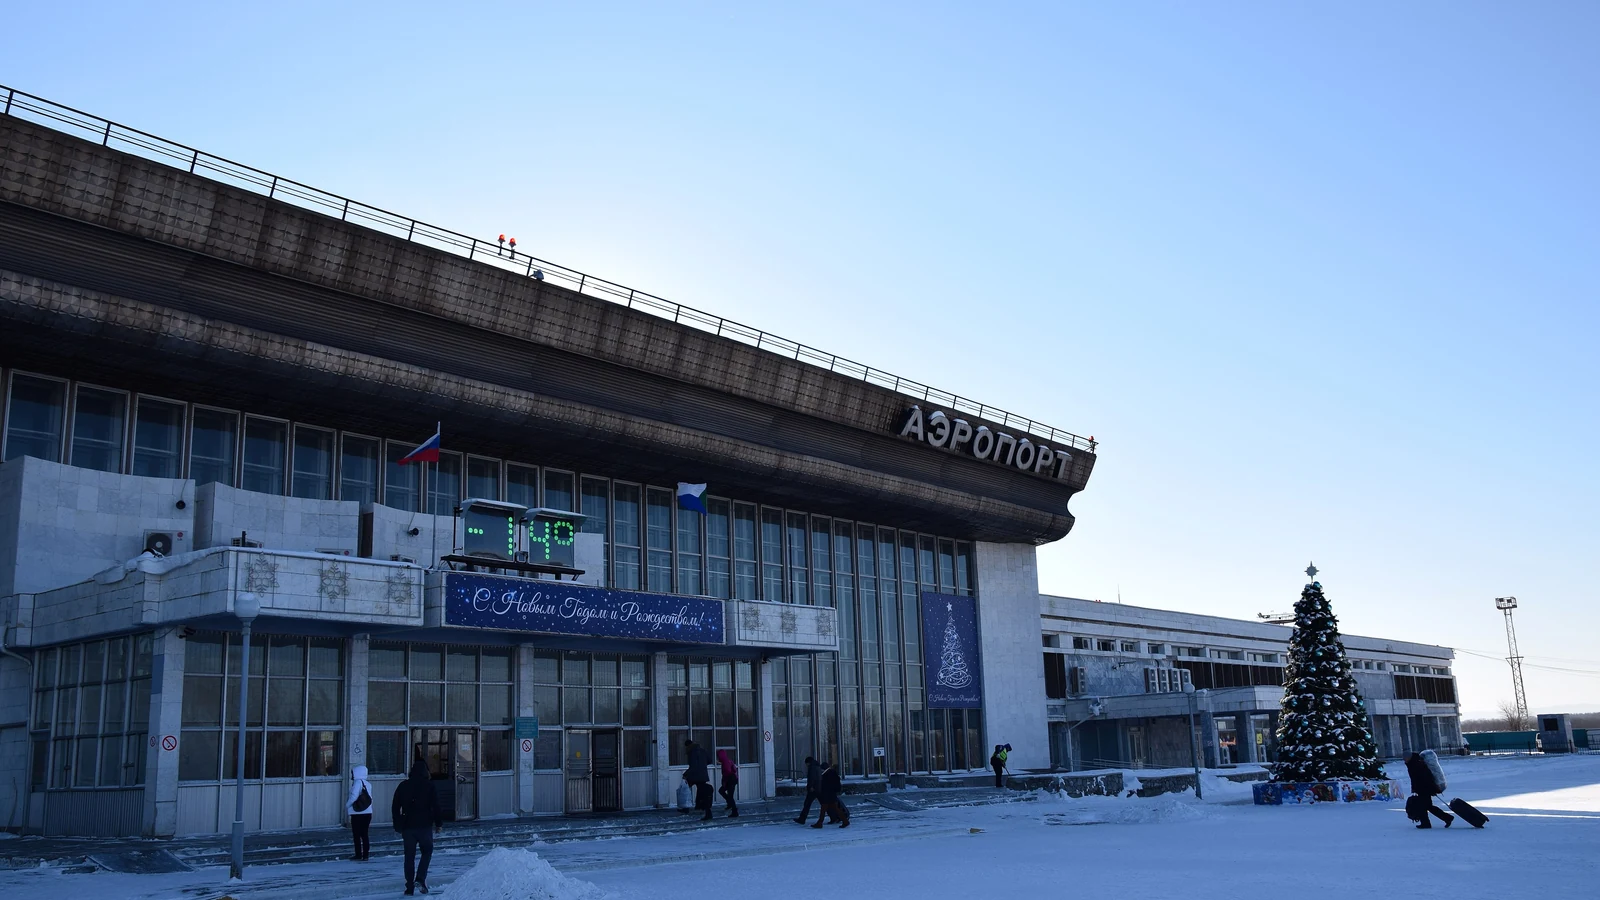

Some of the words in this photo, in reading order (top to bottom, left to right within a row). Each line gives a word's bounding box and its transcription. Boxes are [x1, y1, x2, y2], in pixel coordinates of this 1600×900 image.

[900, 408, 1073, 479] АЭРОПОРТ
[473, 587, 490, 612] С
[490, 590, 555, 615] Новым
[559, 597, 608, 625] Годом
[610, 605, 618, 619] и
[620, 601, 705, 630] Рождеством!
